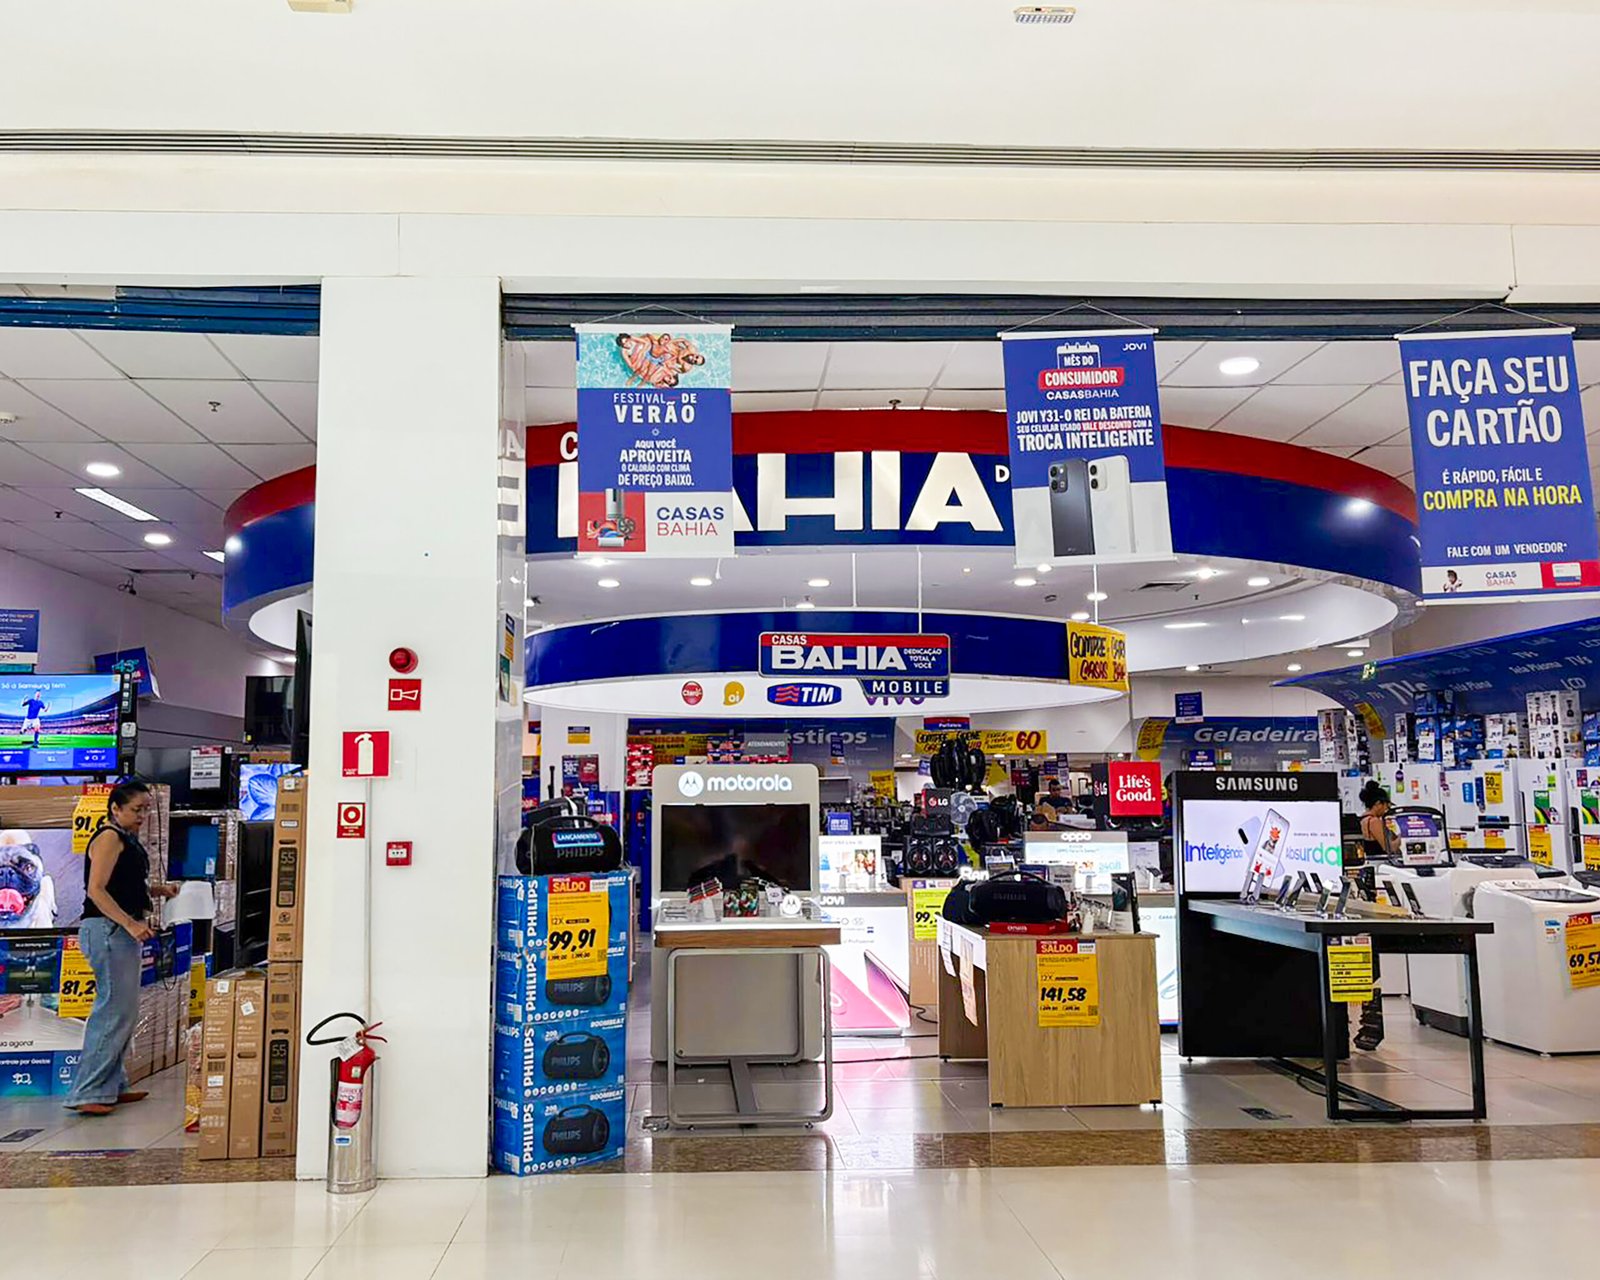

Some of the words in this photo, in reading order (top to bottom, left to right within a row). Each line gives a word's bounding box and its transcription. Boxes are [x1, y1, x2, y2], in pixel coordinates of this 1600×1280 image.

[1122, 343, 1147, 351] JOVI
[1064, 354, 1080, 367] MÊS
[1081, 355, 1094, 366] DO
[1045, 370, 1118, 387] CONSUMIDOR
[1409, 358, 1498, 404] FAÇA
[1503, 355, 1570, 395] SEU
[613, 393, 665, 404] FESTIVAL
[681, 393, 697, 404] DE
[615, 401, 695, 424] VERÃO
[1016, 411, 1039, 425] JOVI
[1075, 409, 1091, 422] REI
[1093, 408, 1107, 421] DA
[1110, 405, 1152, 420] BATERIA
[1017, 425, 1029, 434] SEU
[1030, 424, 1059, 433] CELULAR
[1060, 422, 1081, 431] USADO
[1081, 421, 1098, 431] VALE
[1098, 420, 1132, 430] DESCONTO
[1133, 419, 1147, 429] COM
[1427, 398, 1562, 448] CARTÃO
[635, 440, 655, 449] AQUI
[655, 438, 676, 449] VOCÊ
[1017, 433, 1064, 452] TROCA
[1066, 429, 1154, 450] INTELIGENTE
[620, 449, 692, 463] APROVEITA
[621, 464, 627, 473] O
[628, 462, 654, 473] CALORÃO
[655, 463, 669, 472] COM
[670, 463, 691, 472] CLIMA
[618, 474, 631, 486] DE
[632, 474, 663, 488] PREÇO
[664, 474, 695, 486] BAIXO.
[1442, 469, 1451, 485] É
[1453, 467, 1499, 485] RÁPIDO,
[1502, 466, 1534, 483] FÁCIL
[1535, 467, 1543, 481] E
[1423, 489, 1498, 511] COMPRA
[1504, 487, 1529, 508] NA
[1533, 484, 1583, 506] HORA
[656, 507, 724, 520] CASAS
[657, 523, 718, 536] BAHIA
[1447, 545, 1469, 558] FALE
[1470, 545, 1491, 557] COM
[1494, 544, 1510, 556] UM
[1485, 571, 1517, 579] CASAS
[1486, 578, 1515, 587] BAHIA
[771, 635, 807, 646] CASAS
[771, 645, 907, 671] BAHIA
[903, 648, 942, 656] DEDICAÇÃO
[914, 661, 932, 669] VOCÊ
[872, 681, 943, 694] MOBILE
[801, 687, 834, 703] TIM
[1016, 731, 1041, 750] 60
[1194, 727, 1321, 743] Geladeira
[707, 773, 792, 791] motorola
[1119, 774, 1151, 789] Life's
[1216, 777, 1299, 791] SAMSUNG
[87, 787, 112, 796] SALD
[1116, 788, 1156, 802] Good.
[938, 798, 949, 806] LG
[75, 816, 106, 833] 91,6
[557, 832, 598, 841] LANÇAMENTO
[1061, 832, 1092, 842] oppo
[557, 849, 604, 858] PHILIPS
[553, 881, 586, 892] SALDO
[820, 896, 845, 905] JOVI
[527, 880, 539, 937] PHILIPS
[549, 928, 596, 952] 99,91
[1041, 944, 1073, 953] SALDO
[62, 980, 96, 996] 81,2
[526, 953, 537, 1012] PHILIPS
[1041, 987, 1087, 1003] 141,58
[9, 1040, 34, 1048] agora!
[272, 1043, 287, 1057] 55
[523, 1027, 535, 1087] PHILIPS
[523, 1103, 534, 1163] PHILIPS
